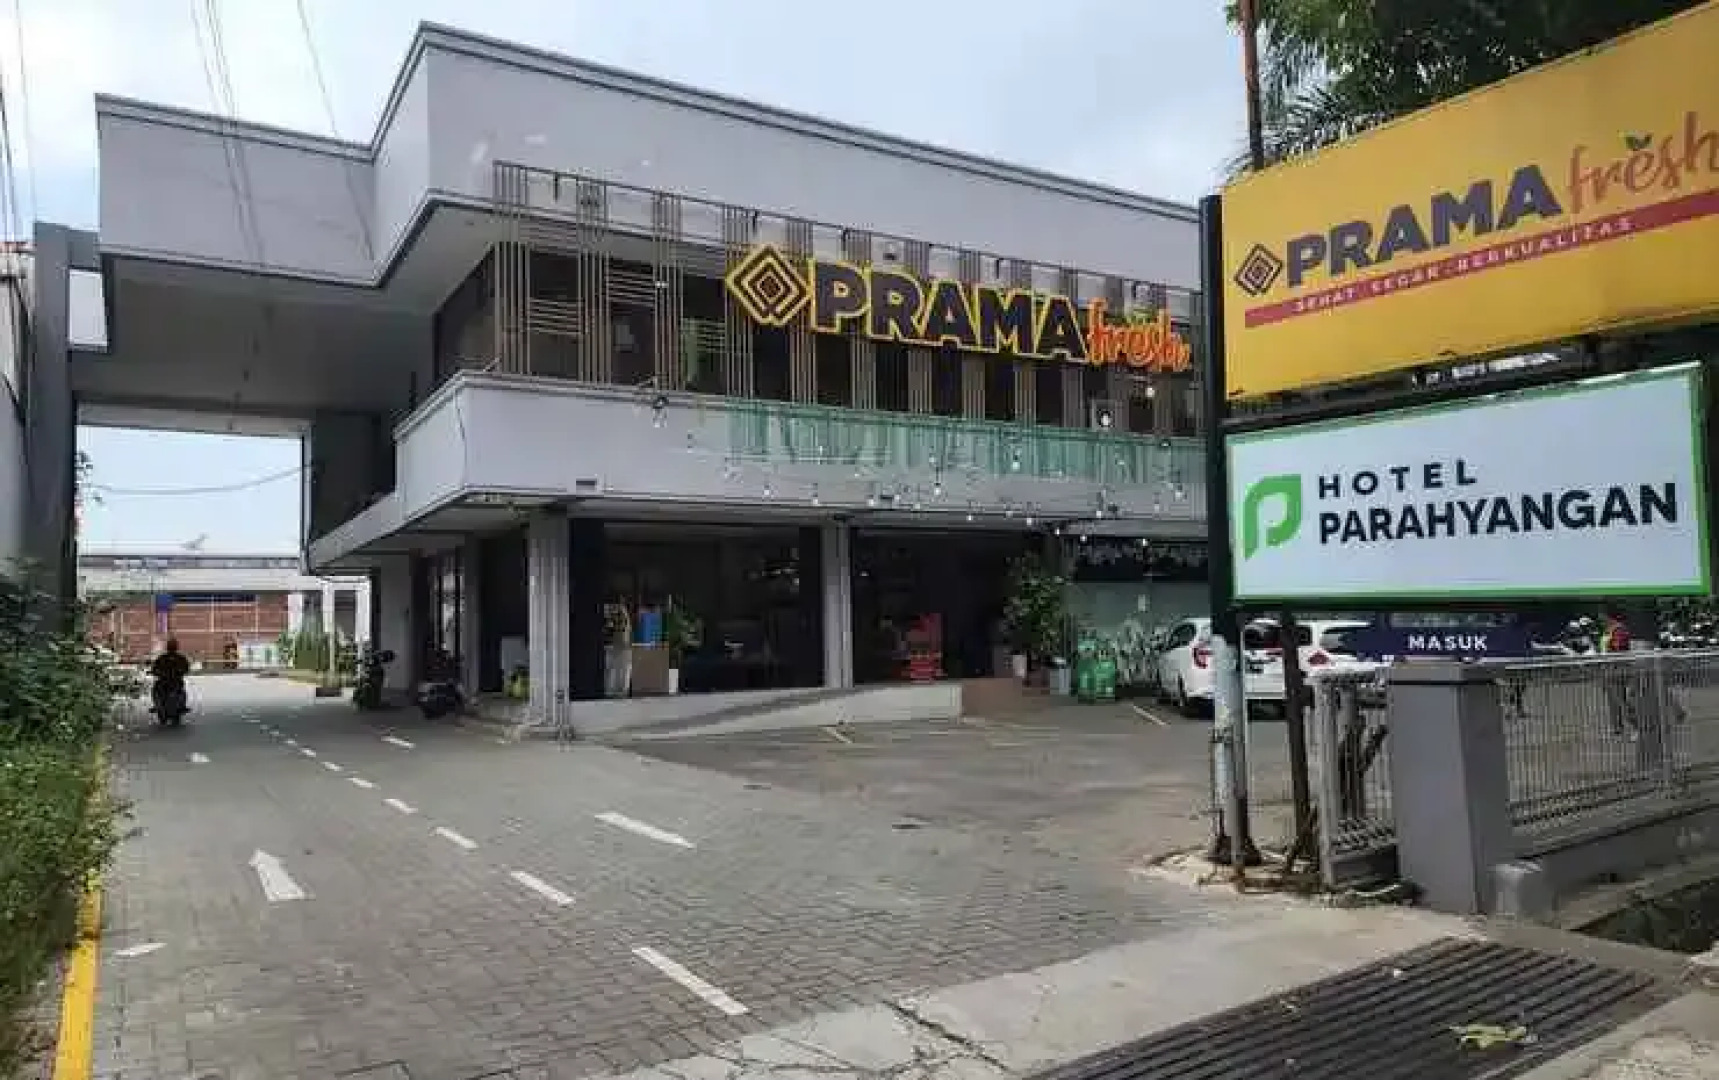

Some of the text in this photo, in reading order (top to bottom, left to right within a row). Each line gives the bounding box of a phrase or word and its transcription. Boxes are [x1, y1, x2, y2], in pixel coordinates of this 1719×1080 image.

[1287, 111, 1719, 288] PRAMA fresh
[806, 254, 1192, 373] PRAMA fresh
[1318, 459, 1478, 500] HOTEL
[1319, 482, 1678, 545] PARAHYANGAN
[1408, 633, 1489, 652] MASUK
